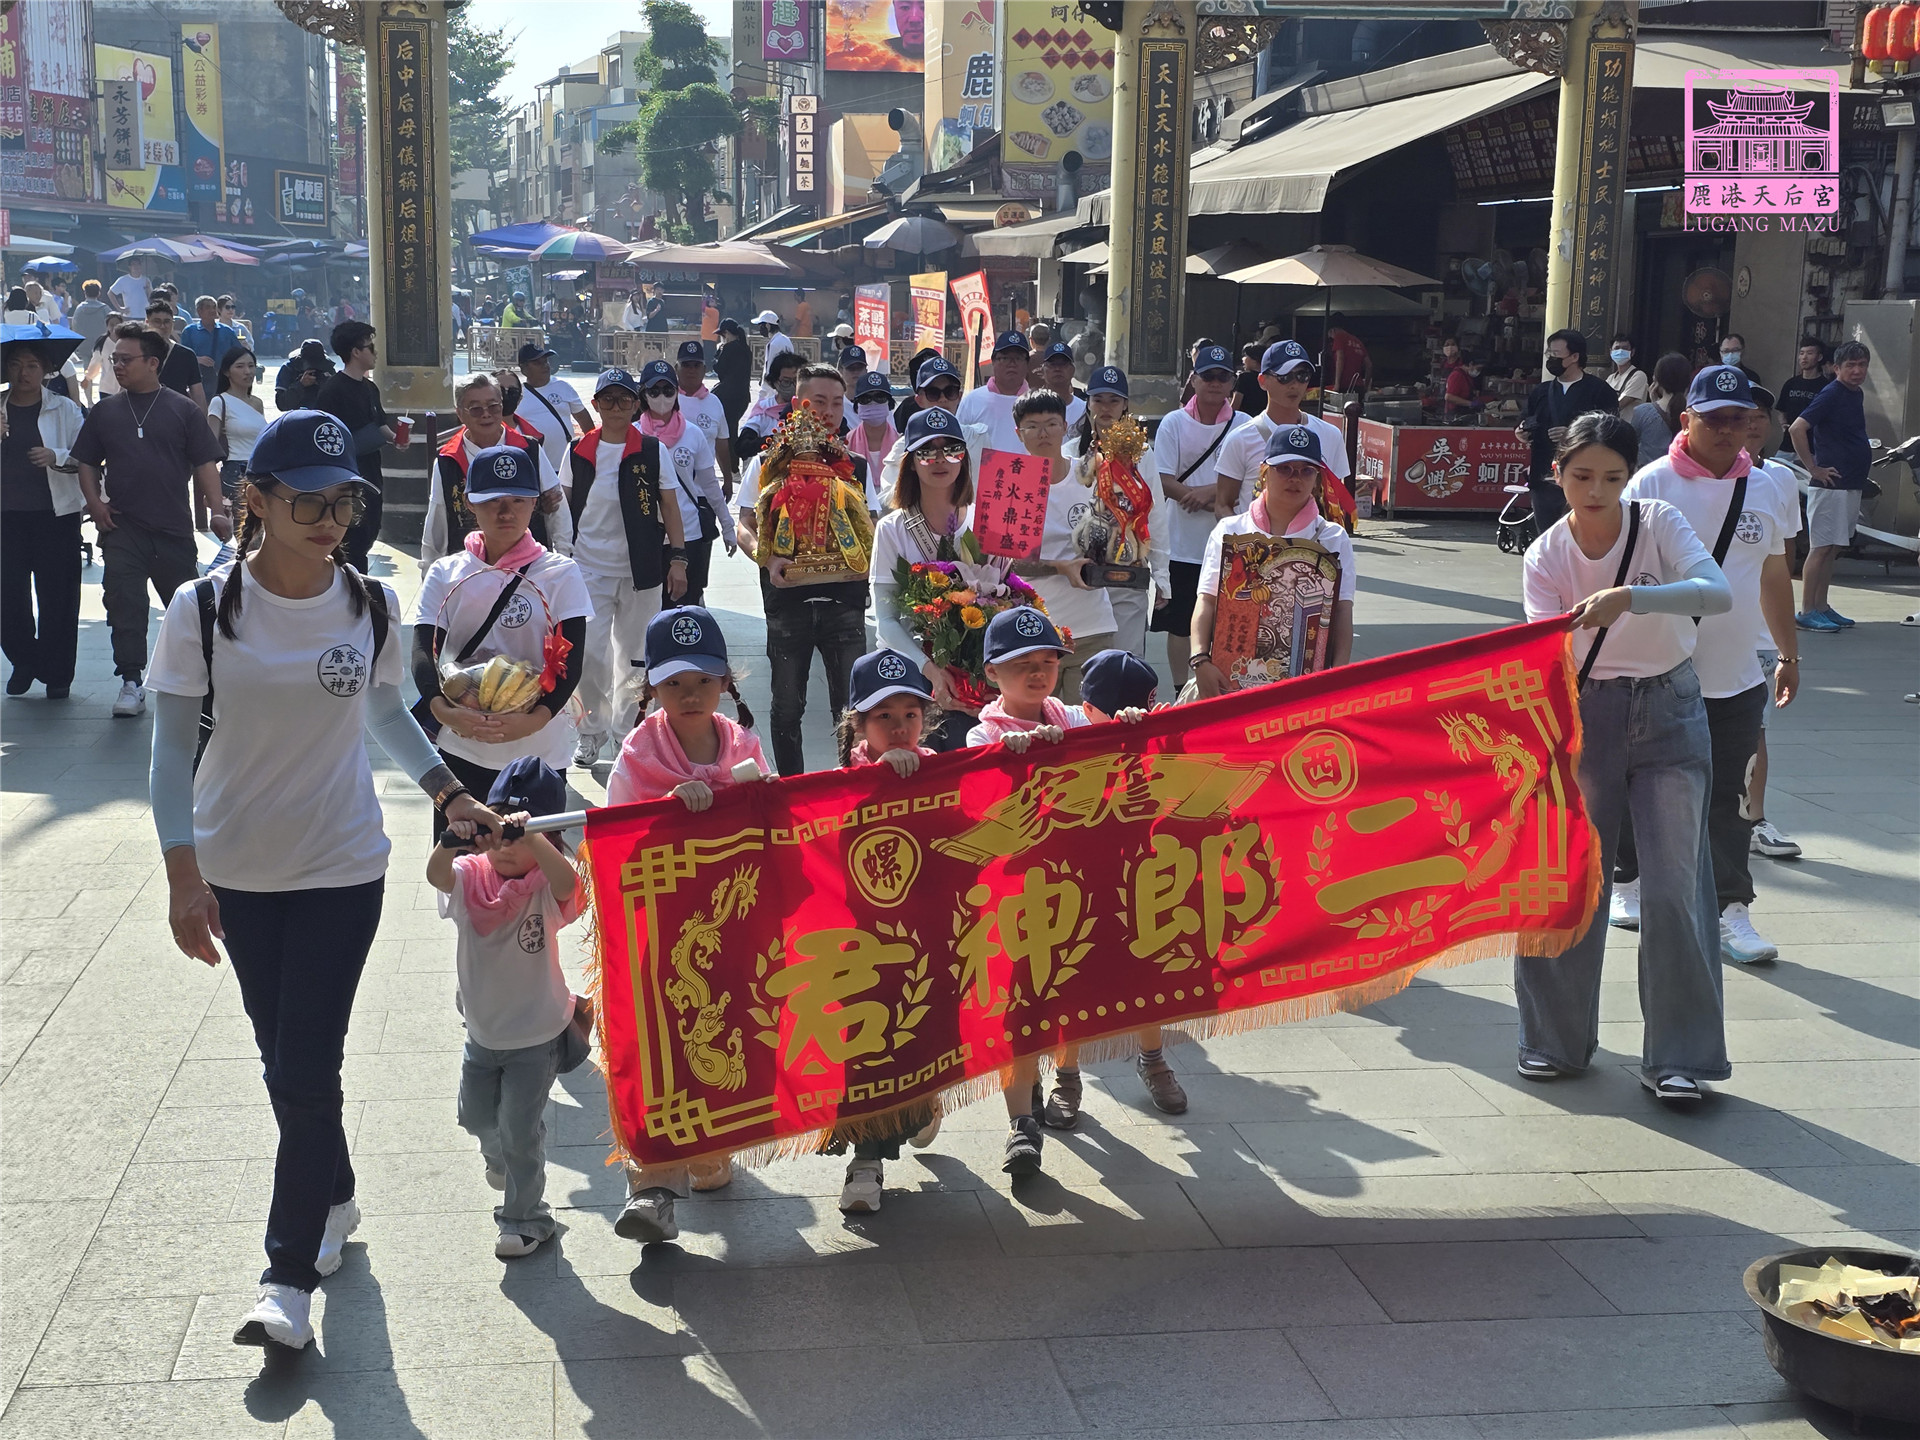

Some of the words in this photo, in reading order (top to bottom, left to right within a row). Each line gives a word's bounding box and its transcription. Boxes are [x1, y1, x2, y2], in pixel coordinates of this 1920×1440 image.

[1051, 5, 1099, 24] 蚵仔
[193, 59, 208, 116] 公益彩券
[1789, 389, 1818, 400] DICKIE
[1478, 463, 1531, 485] 蚵仔
[1000, 457, 1025, 550] 香火鼎盛
[1017, 493, 1034, 552] 天上聖母
[1302, 741, 1342, 789] 西
[863, 836, 906, 890] 螺
